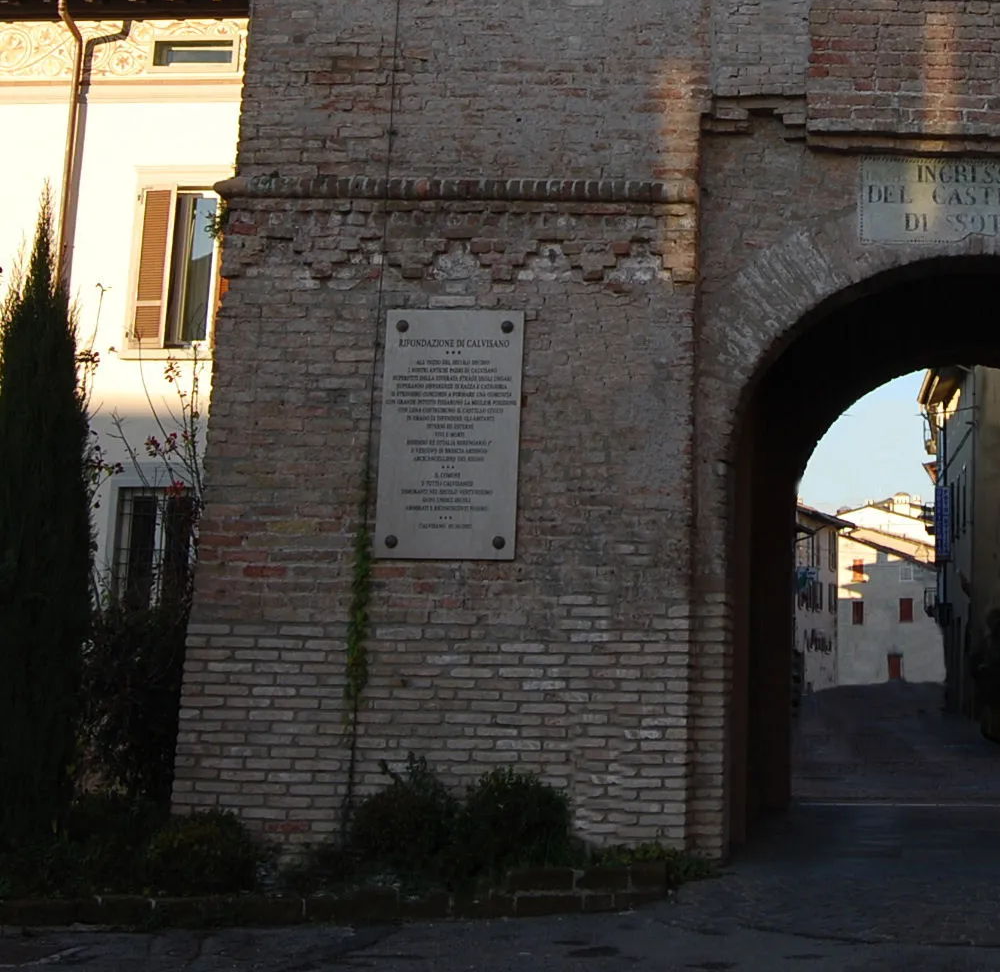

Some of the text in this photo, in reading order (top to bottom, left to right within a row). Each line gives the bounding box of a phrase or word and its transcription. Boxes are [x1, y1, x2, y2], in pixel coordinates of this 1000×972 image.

[867, 184, 913, 205] DEL
[904, 212, 928, 232] DI
[456, 338, 465, 348] DI
[466, 338, 510, 348] CALVISANO
